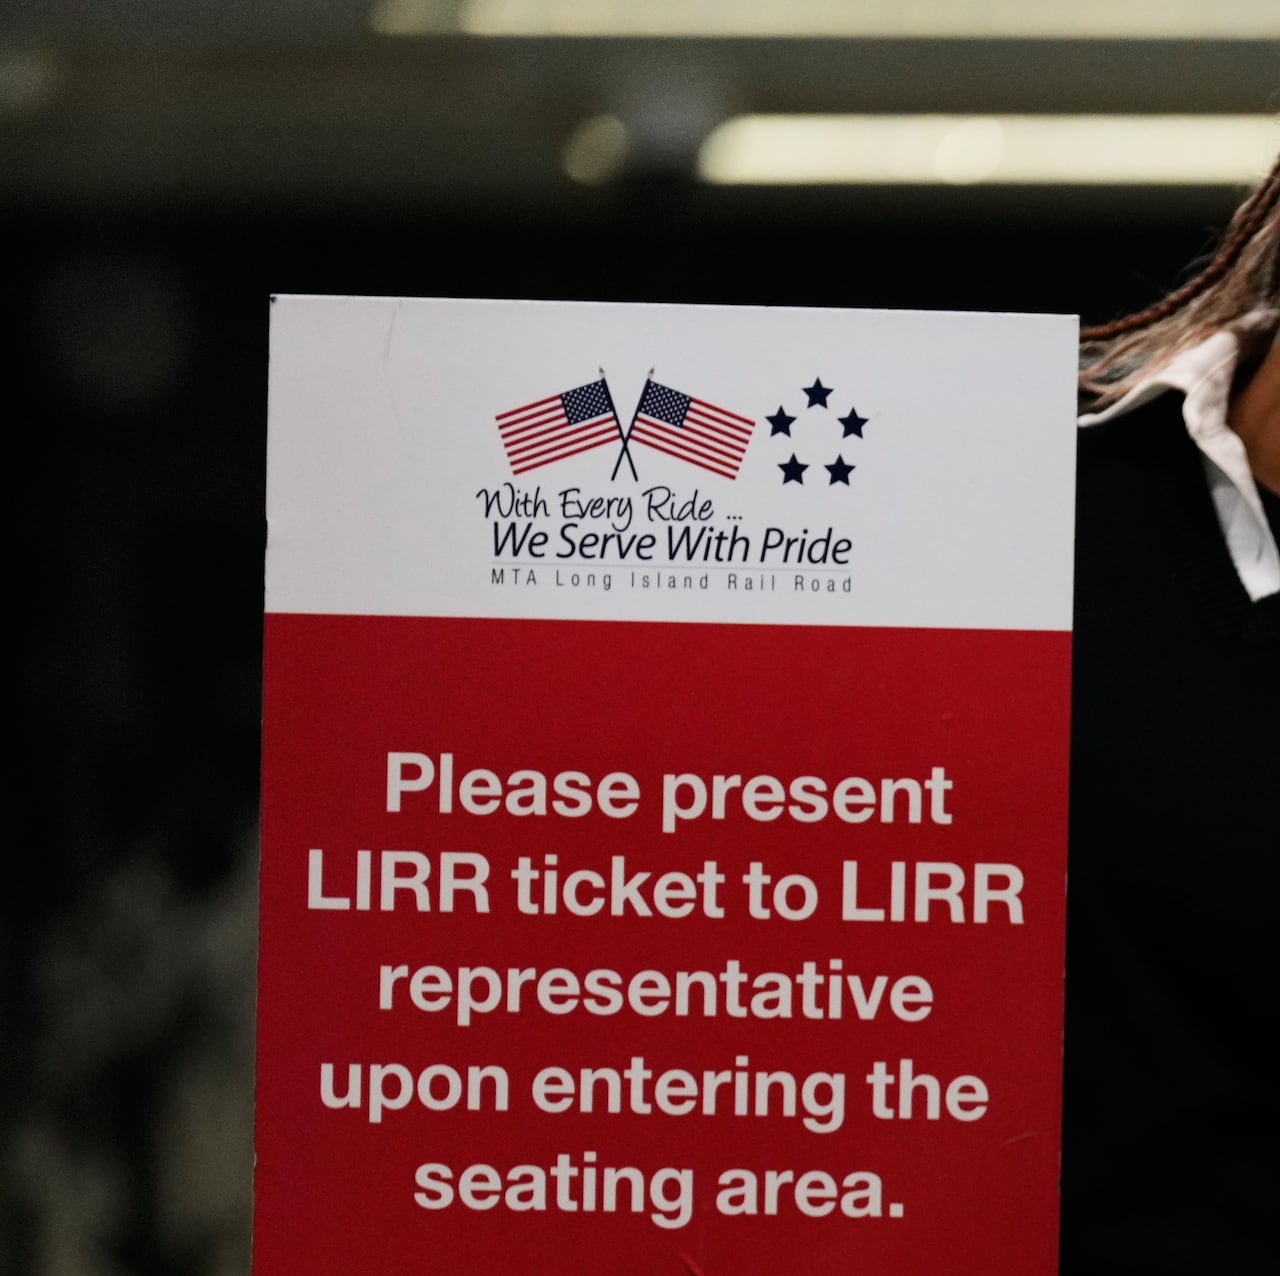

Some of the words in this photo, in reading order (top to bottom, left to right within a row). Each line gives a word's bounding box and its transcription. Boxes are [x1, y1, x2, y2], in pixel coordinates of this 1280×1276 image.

[475, 482, 550, 519] With
[558, 488, 633, 533] Every
[642, 486, 715, 522] Ride
[493, 521, 549, 559] We
[556, 523, 657, 561] Serve
[667, 525, 751, 563] With
[760, 527, 853, 565] Pride
[490, 568, 537, 586] MTA
[555, 571, 612, 591] Long
[631, 571, 709, 590] Island
[727, 573, 775, 591] Rail
[795, 575, 852, 592] Road
[386, 751, 640, 819] Please
[662, 766, 954, 834] present
[307, 848, 490, 913] LIRR
[510, 853, 726, 919] ticket
[742, 861, 819, 921] to
[842, 860, 1024, 925] LIRR
[379, 958, 934, 1027] representative
[320, 1063, 509, 1124] upon
[531, 1056, 846, 1134] entering
[866, 1058, 989, 1122] the
[414, 1151, 694, 1229] seating
[716, 1169, 904, 1218] area.
